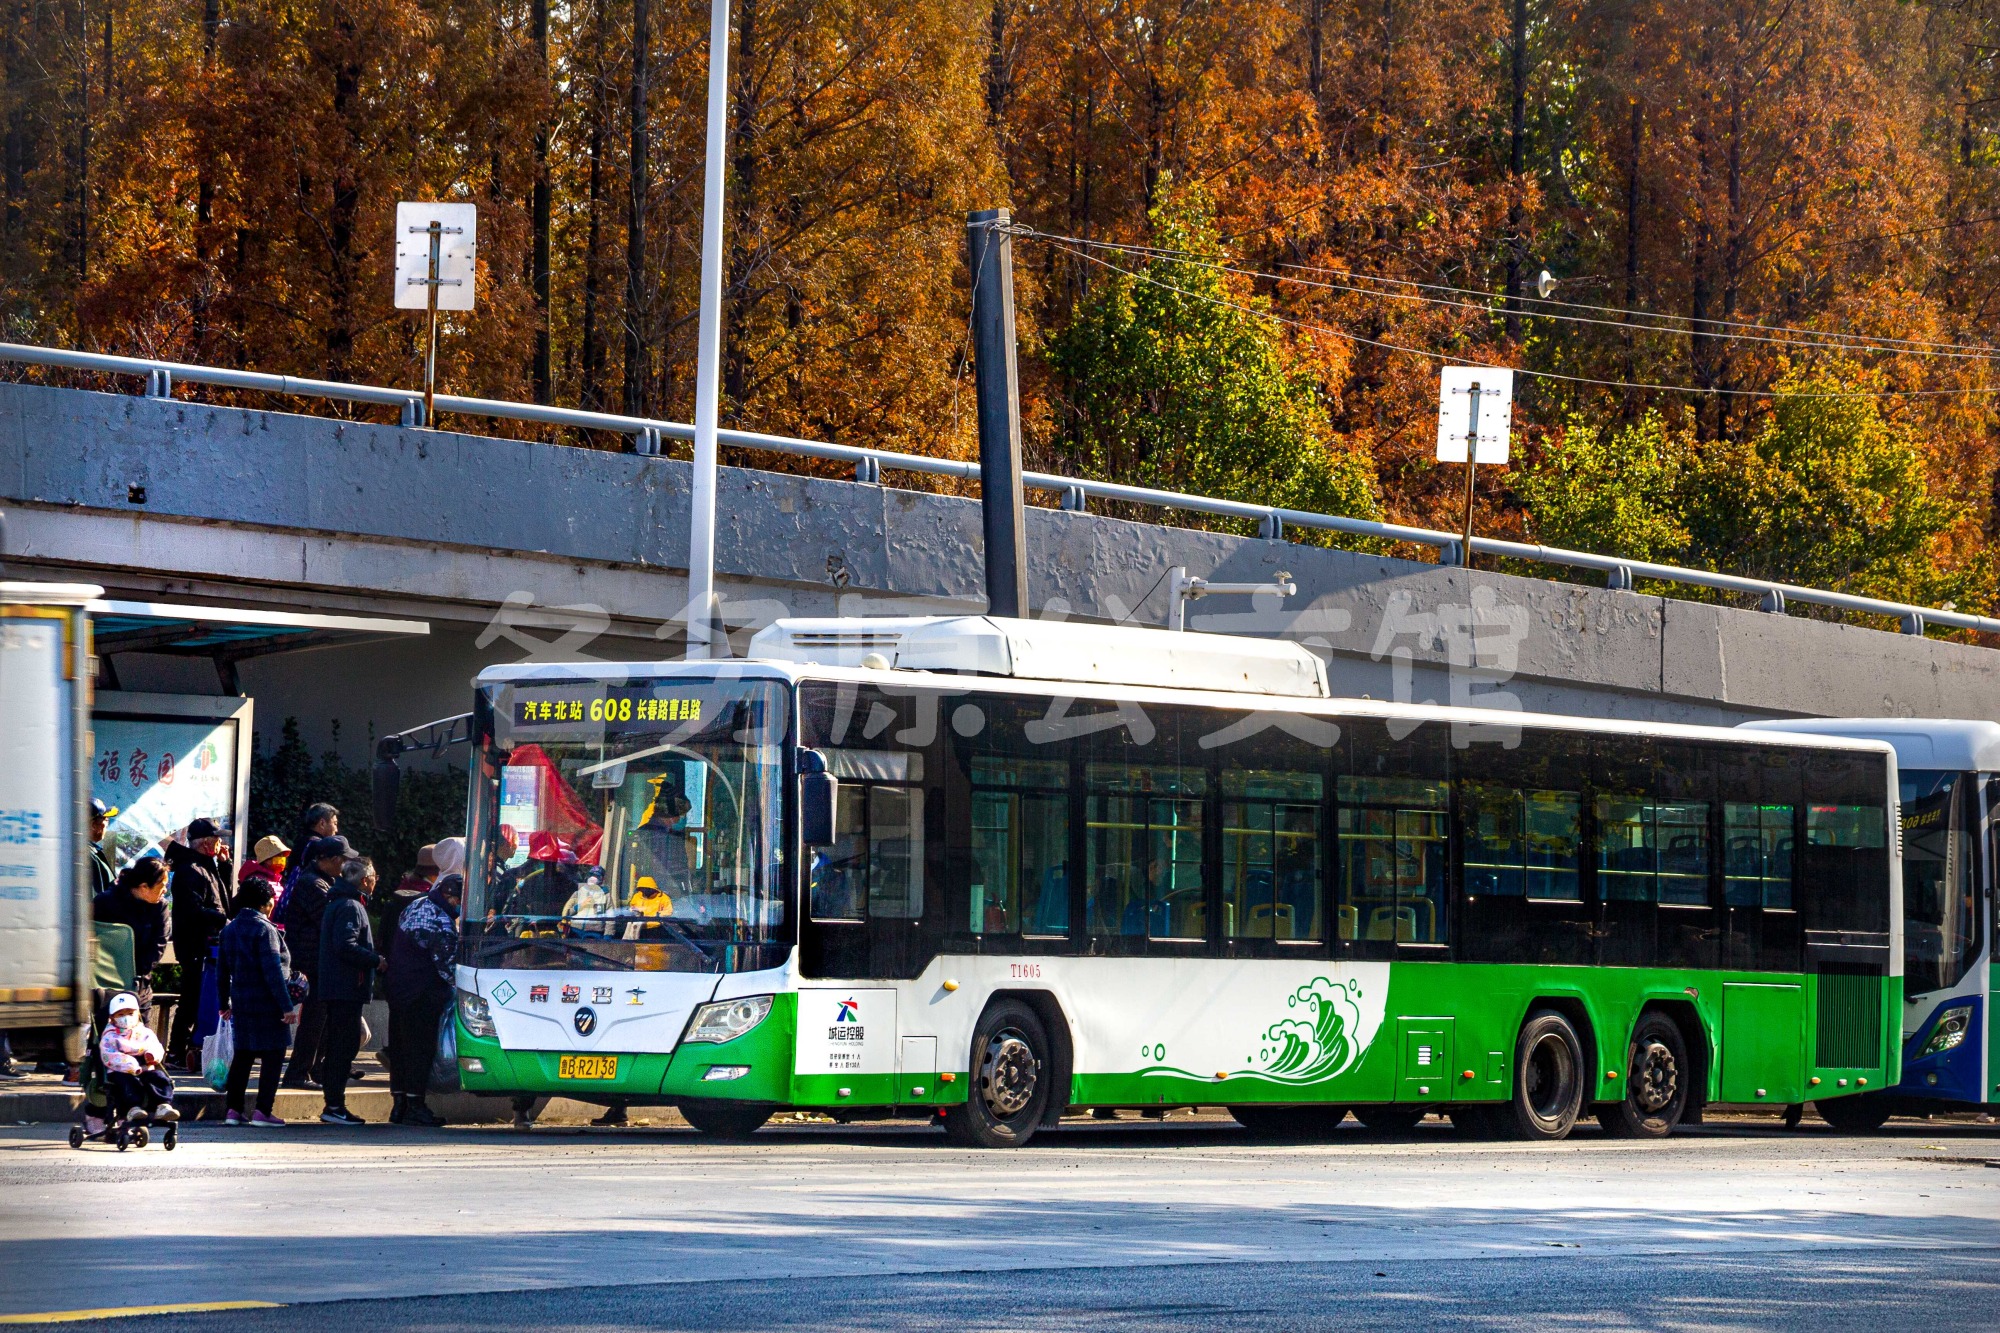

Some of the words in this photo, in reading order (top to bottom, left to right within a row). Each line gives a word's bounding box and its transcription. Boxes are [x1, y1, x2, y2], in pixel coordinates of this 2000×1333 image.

[524, 701, 583, 720] 汽车北站
[590, 698, 632, 721] 608
[637, 699, 701, 720] 长春路曹县路
[1010, 963, 1041, 978] T1605
[496, 988, 512, 998] CNG
[529, 984, 647, 1005] 青岛巴士
[828, 1026, 864, 1041] 城运控股
